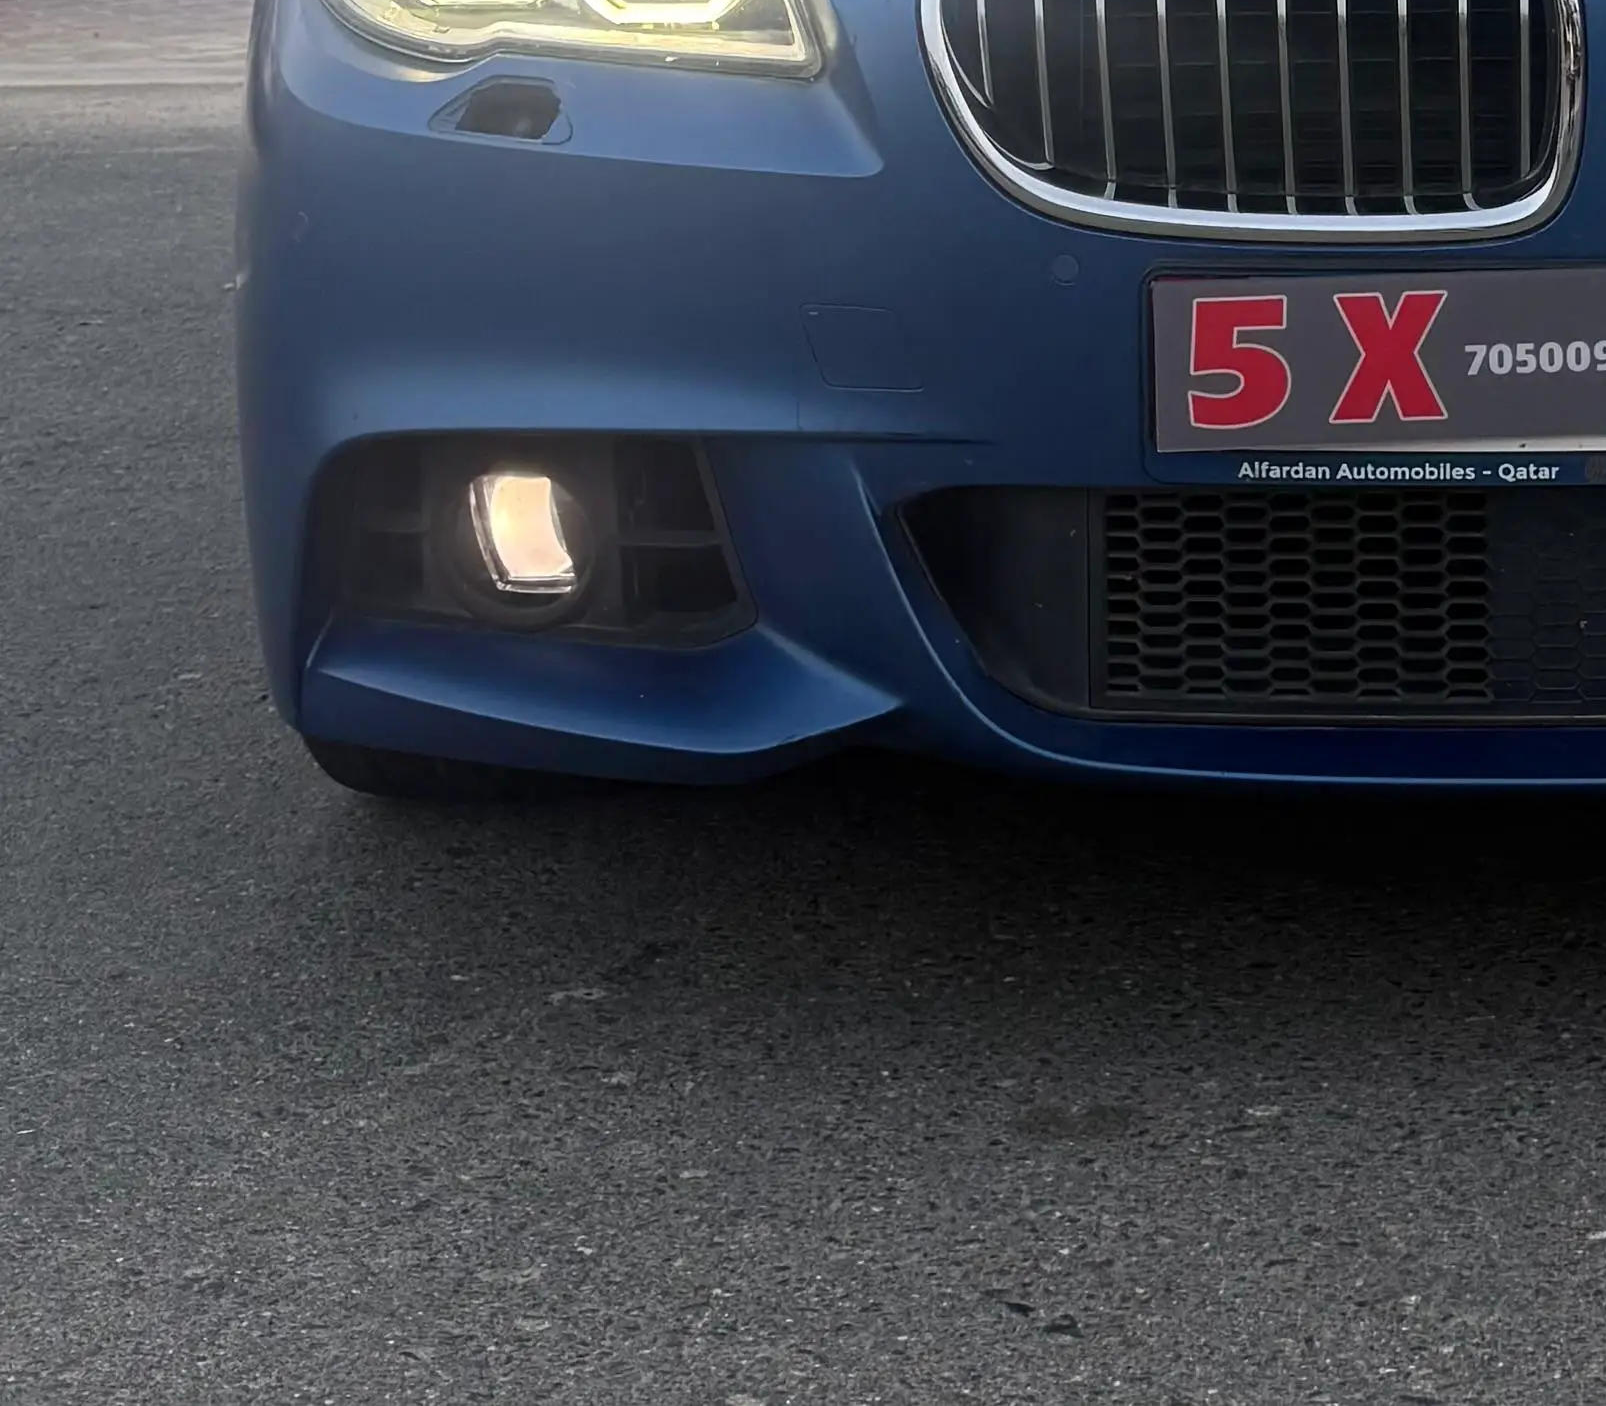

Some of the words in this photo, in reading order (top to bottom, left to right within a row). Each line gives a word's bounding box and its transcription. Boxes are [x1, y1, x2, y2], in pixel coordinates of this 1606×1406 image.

[1187, 294, 1293, 430] 5
[1328, 289, 1450, 424] X
[1238, 461, 1330, 480] Alfardan
[1335, 462, 1476, 481] Automobiles
[1498, 463, 1560, 483] Qatar
